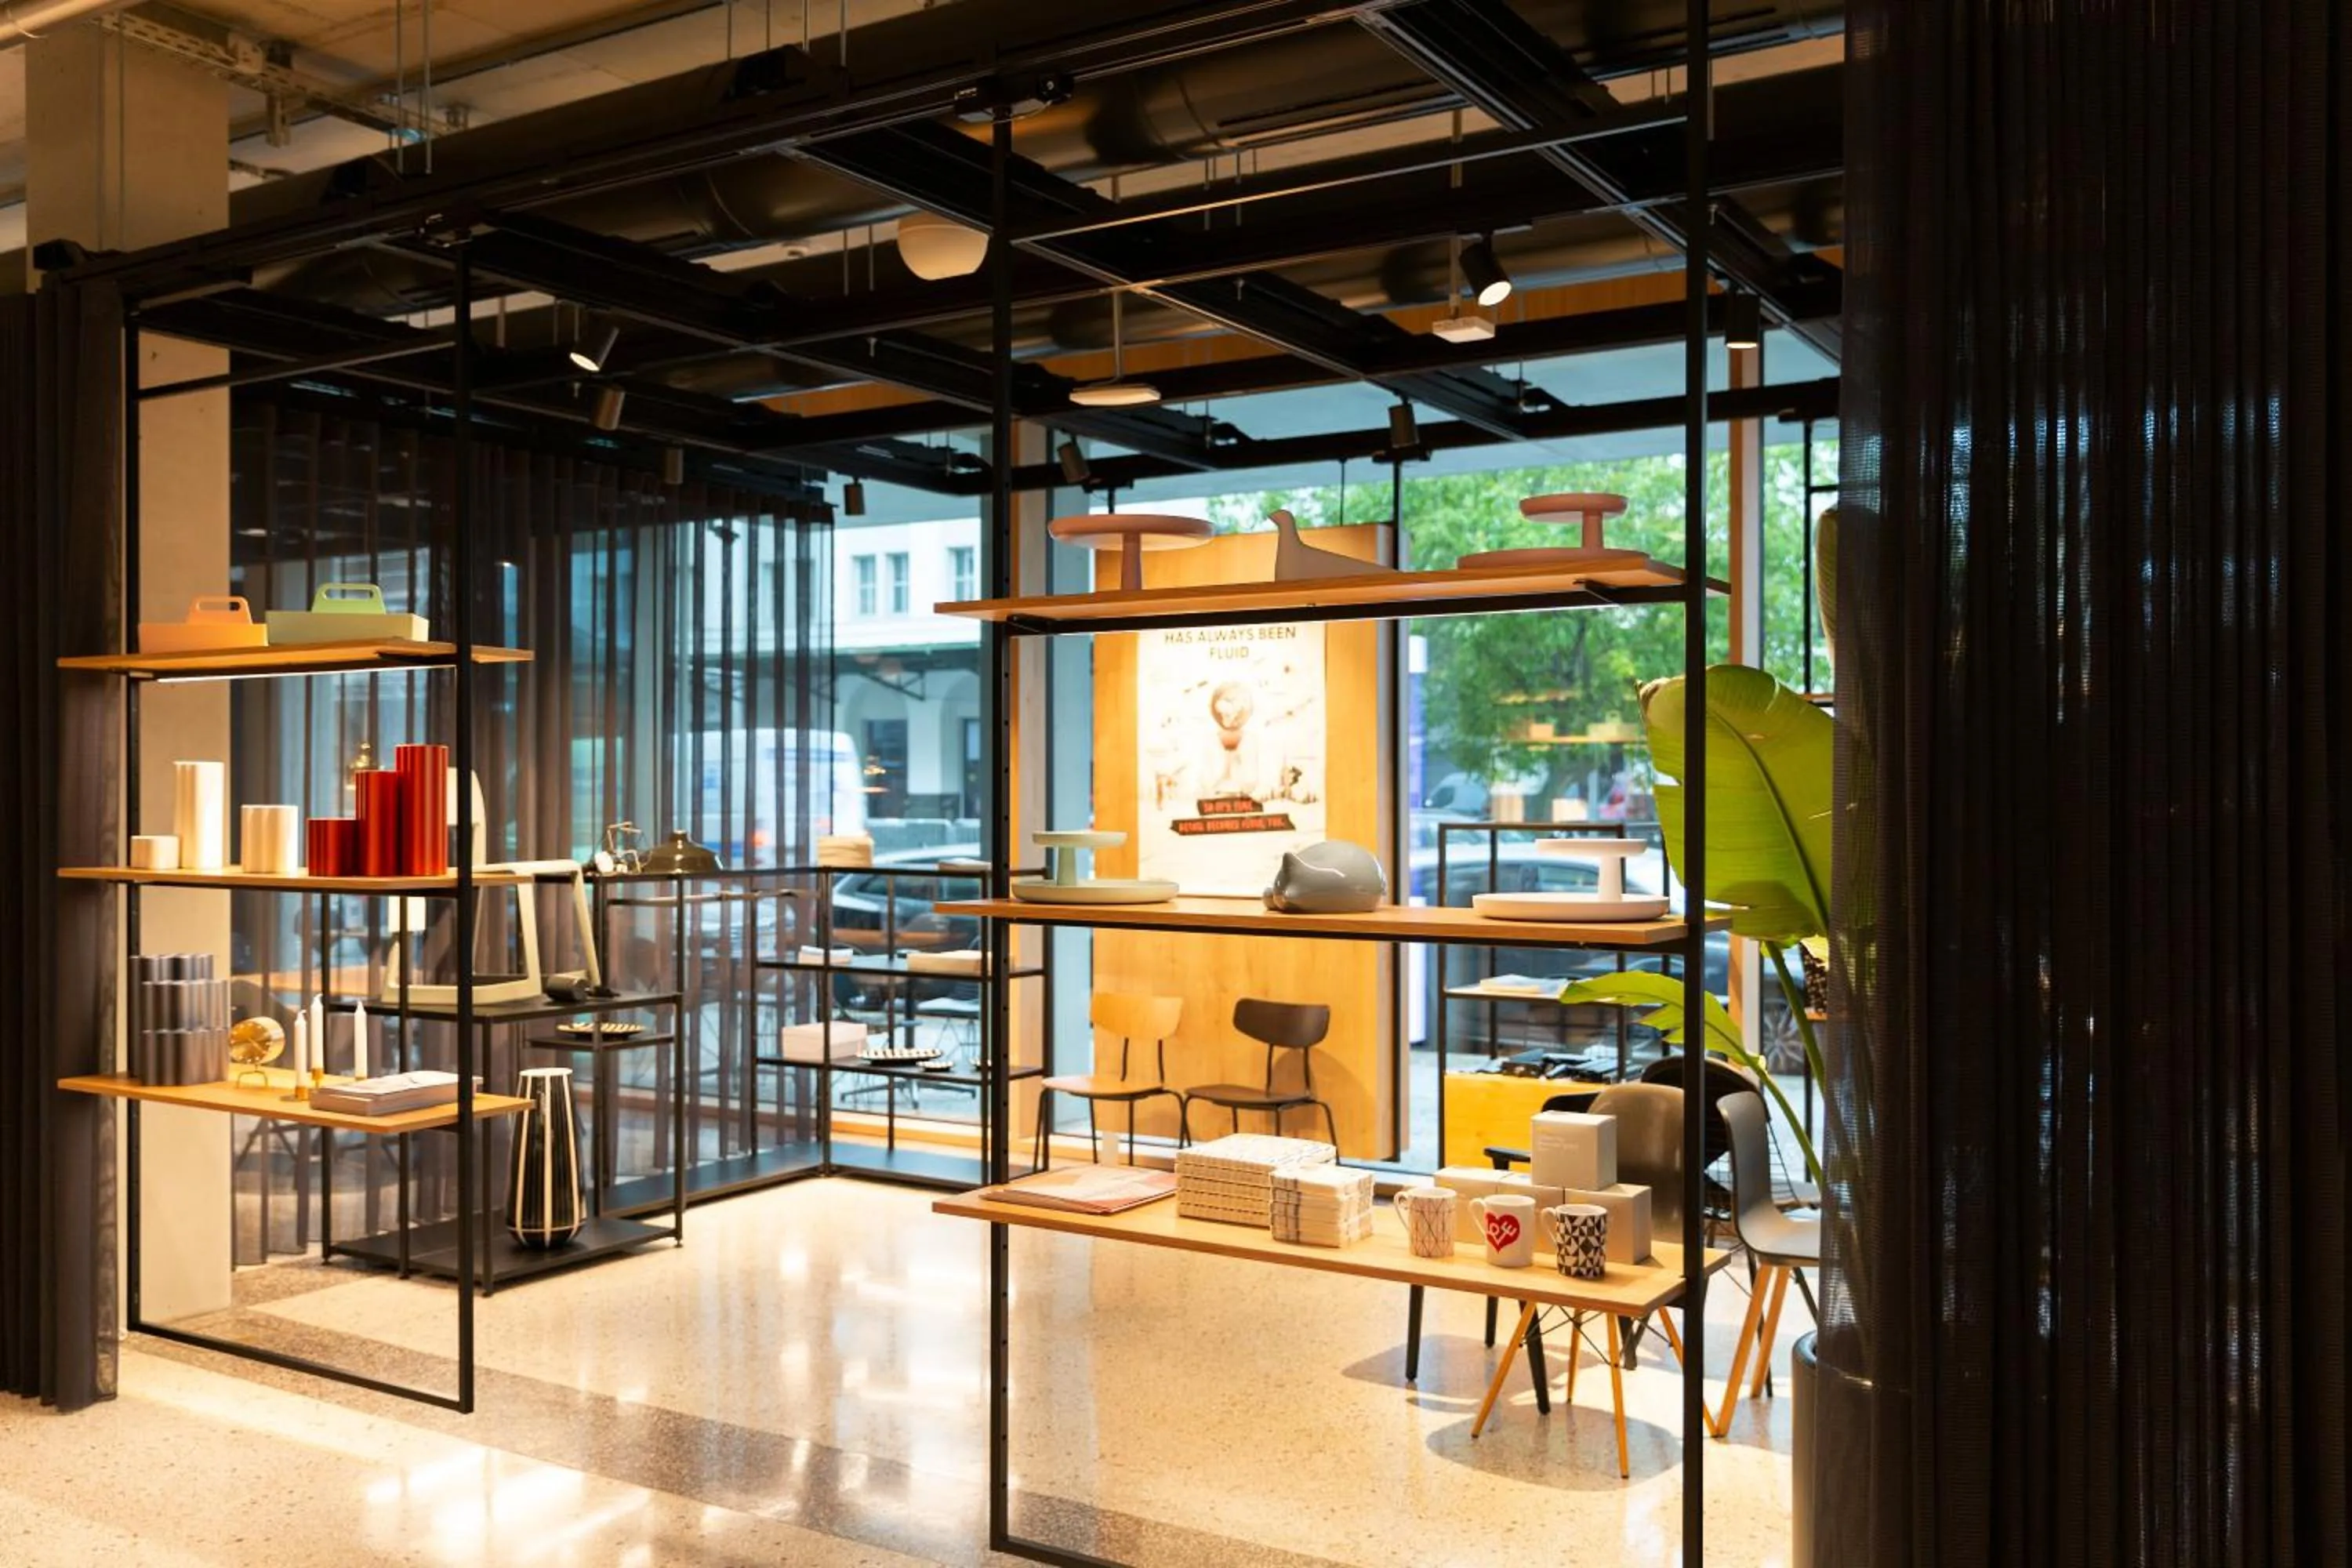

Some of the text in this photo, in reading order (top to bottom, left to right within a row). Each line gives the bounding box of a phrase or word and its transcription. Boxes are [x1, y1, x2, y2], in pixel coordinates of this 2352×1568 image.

[1165, 626, 1296, 644] HAS ALWAYS BEEN
[1210, 646, 1250, 659] FLUID
